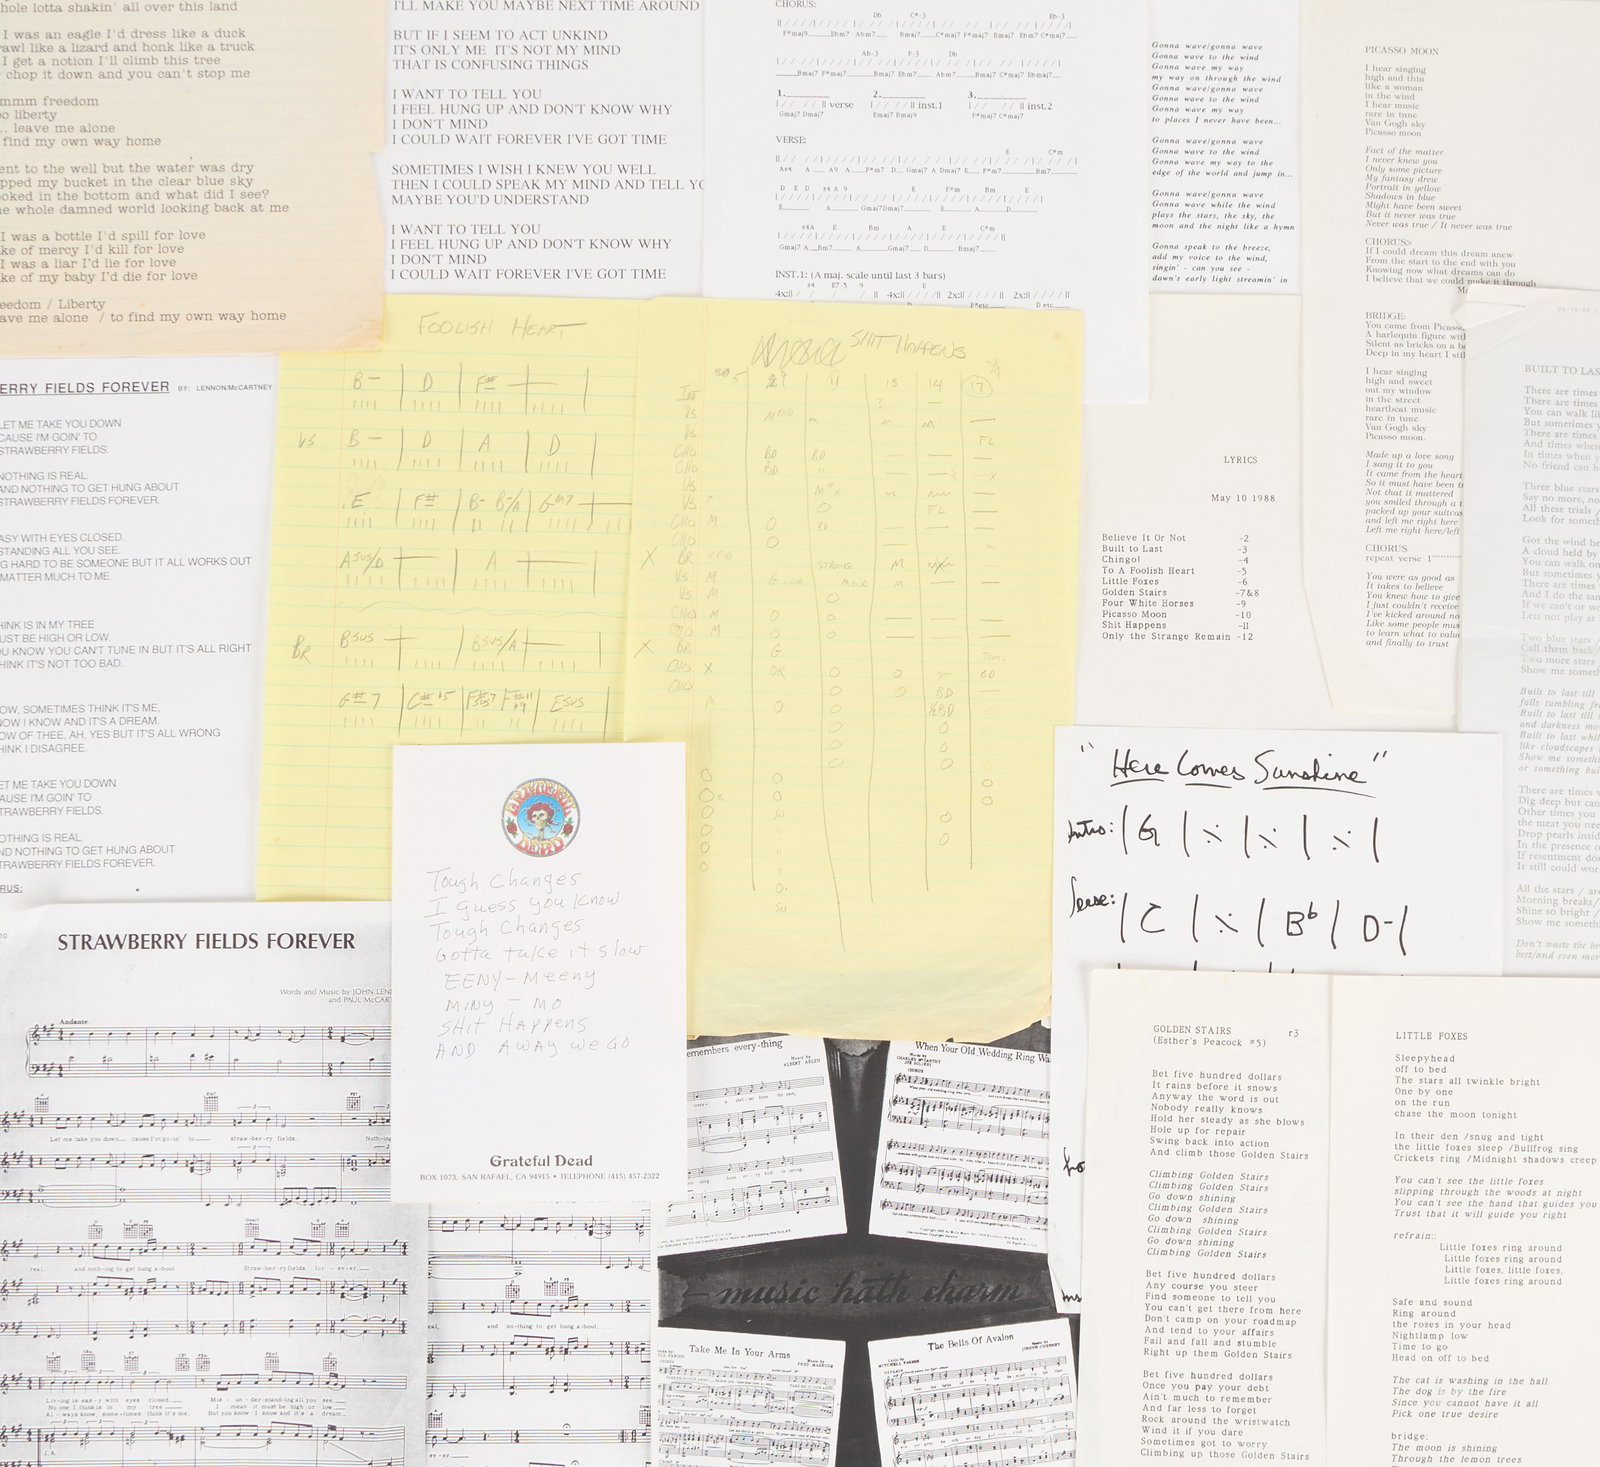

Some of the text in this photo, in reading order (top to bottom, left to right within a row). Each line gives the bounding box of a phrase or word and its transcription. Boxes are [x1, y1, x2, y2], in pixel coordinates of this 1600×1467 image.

[775, 0, 816, 8] CHORUS:
[3, 28, 246, 42] I was an eagle I'd dress like a duck
[394, 30, 608, 40] BUT IF I SEEM TO ACT UNKIND
[1365, 45, 1439, 55] PICASSO MOON
[1365, 64, 1426, 75] I hear singing
[829, 100, 854, 109] verse
[918, 101, 942, 109] inst.1
[1027, 102, 1052, 110] inst.2
[776, 136, 806, 144] VERSE:
[1152, 242, 1179, 250] Gonna
[1184, 243, 1207, 252] speak
[775, 270, 808, 278] INST.1:
[811, 271, 821, 280] (A
[824, 272, 843, 280] maj.
[846, 271, 869, 279] scale
[871, 271, 893, 280] until
[895, 271, 912, 280] last
[922, 271, 946, 280] bars)
[850, 329, 898, 350] SHIT
[896, 333, 967, 360] HAPPENS
[1525, 364, 1559, 374] BUILT
[1561, 365, 1578, 375] TO
[45, 382, 95, 393] FIELDS
[102, 381, 170, 393] FOREVER
[1224, 456, 1258, 464] LYRICS
[21, 484, 68, 494] NOTHING
[71, 483, 86, 493] TO
[87, 483, 109, 493] GET
[111, 483, 142, 492] HUNG
[144, 482, 180, 491] ABOUT
[1211, 494, 1275, 503] May 10 1988
[1102, 533, 1137, 541] Believe
[1142, 533, 1150, 542] It
[1154, 534, 1165, 542] Or
[1169, 534, 1186, 542] Not
[1102, 588, 1135, 596] Golden
[1139, 588, 1167, 596] Stairs
[1102, 620, 1121, 629] Shit
[1125, 621, 1166, 630] Happens
[1177, 750, 1245, 781] Comes
[516, 834, 564, 855] DEAD
[427, 867, 478, 894] Tough
[423, 896, 448, 918] I
[456, 899, 517, 922] guess
[529, 897, 565, 916] you
[58, 933, 355, 951] STRAWBERRY FIELDS FOREVER
[342, 988, 350, 996] by
[1153, 1025, 1231, 1035] GOLDEN STAIRS
[1153, 1035, 1197, 1045] (Esther's
[1203, 1037, 1242, 1047] Peacock
[1396, 1031, 1468, 1041] LITTLE FOXES
[915, 1041, 938, 1051] When
[941, 1044, 958, 1054] Your
[960, 1046, 975, 1055] Old
[979, 1047, 1013, 1061] Wedding
[1016, 1051, 1035, 1064] Ring
[1395, 1053, 1455, 1064] Sleepyhead
[490, 1154, 593, 1167] Grateful Dead
[717, 1279, 819, 1304] music
[832, 1270, 909, 1304] hath
[927, 1334, 1014, 1351] The Bells Of Avalon
[689, 1345, 790, 1359] Take Me In Your Arms
